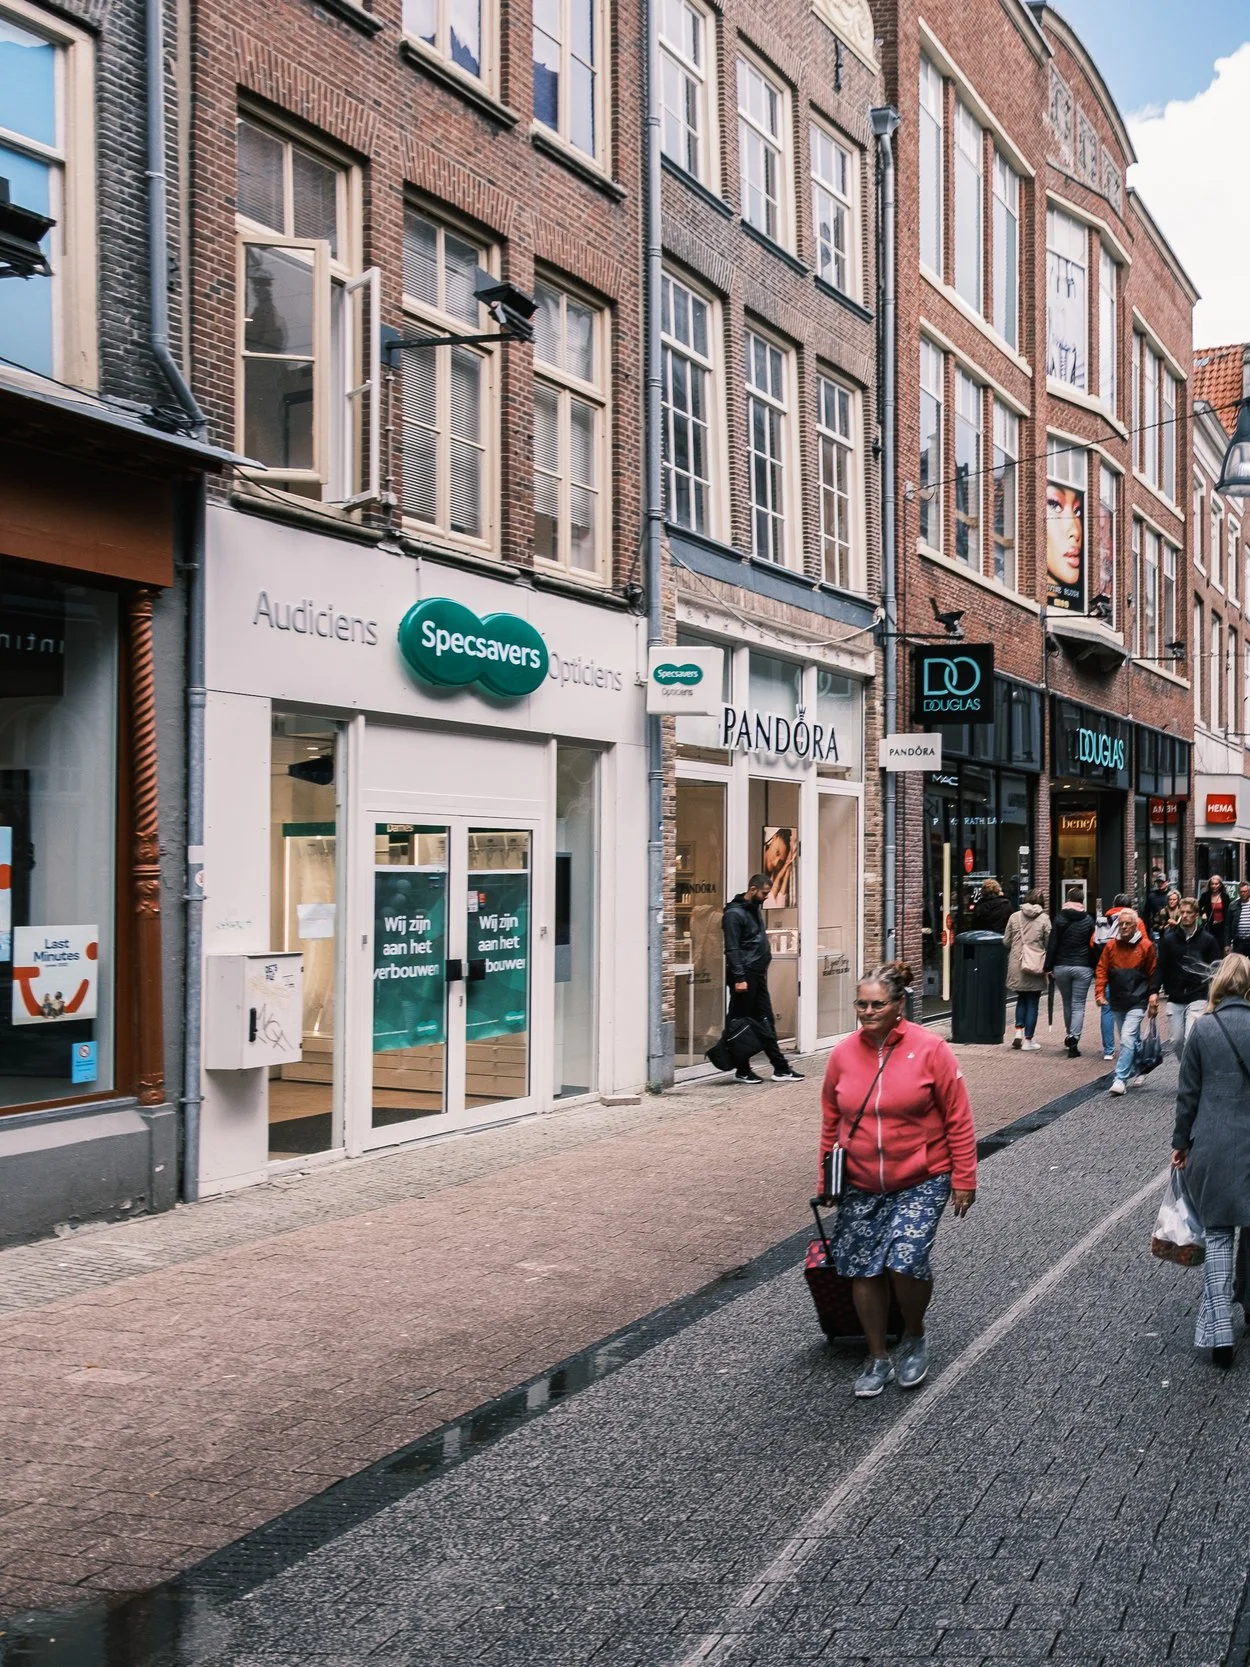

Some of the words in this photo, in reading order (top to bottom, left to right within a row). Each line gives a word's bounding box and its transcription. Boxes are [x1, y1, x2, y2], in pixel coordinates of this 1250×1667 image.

[253, 590, 378, 645] Audiciens
[422, 620, 541, 669] Specsavers
[549, 651, 623, 691] Opticiens
[657, 669, 699, 680] Specsavers
[923, 699, 981, 711] DOUGLAS
[1079, 727, 1125, 770] DOUGLAS
[1207, 804, 1234, 813] HEMA
[384, 916, 407, 935] Wij
[408, 915, 432, 935] zijn
[478, 915, 498, 933] Wij
[499, 914, 519, 932] zijn
[44, 938, 70, 950] Last
[382, 942, 408, 956] aan
[410, 939, 433, 954] het
[478, 937, 499, 951] aan
[499, 935, 520, 949] het
[33, 950, 80, 962] Minutes
[373, 963, 440, 980] verbouwen
